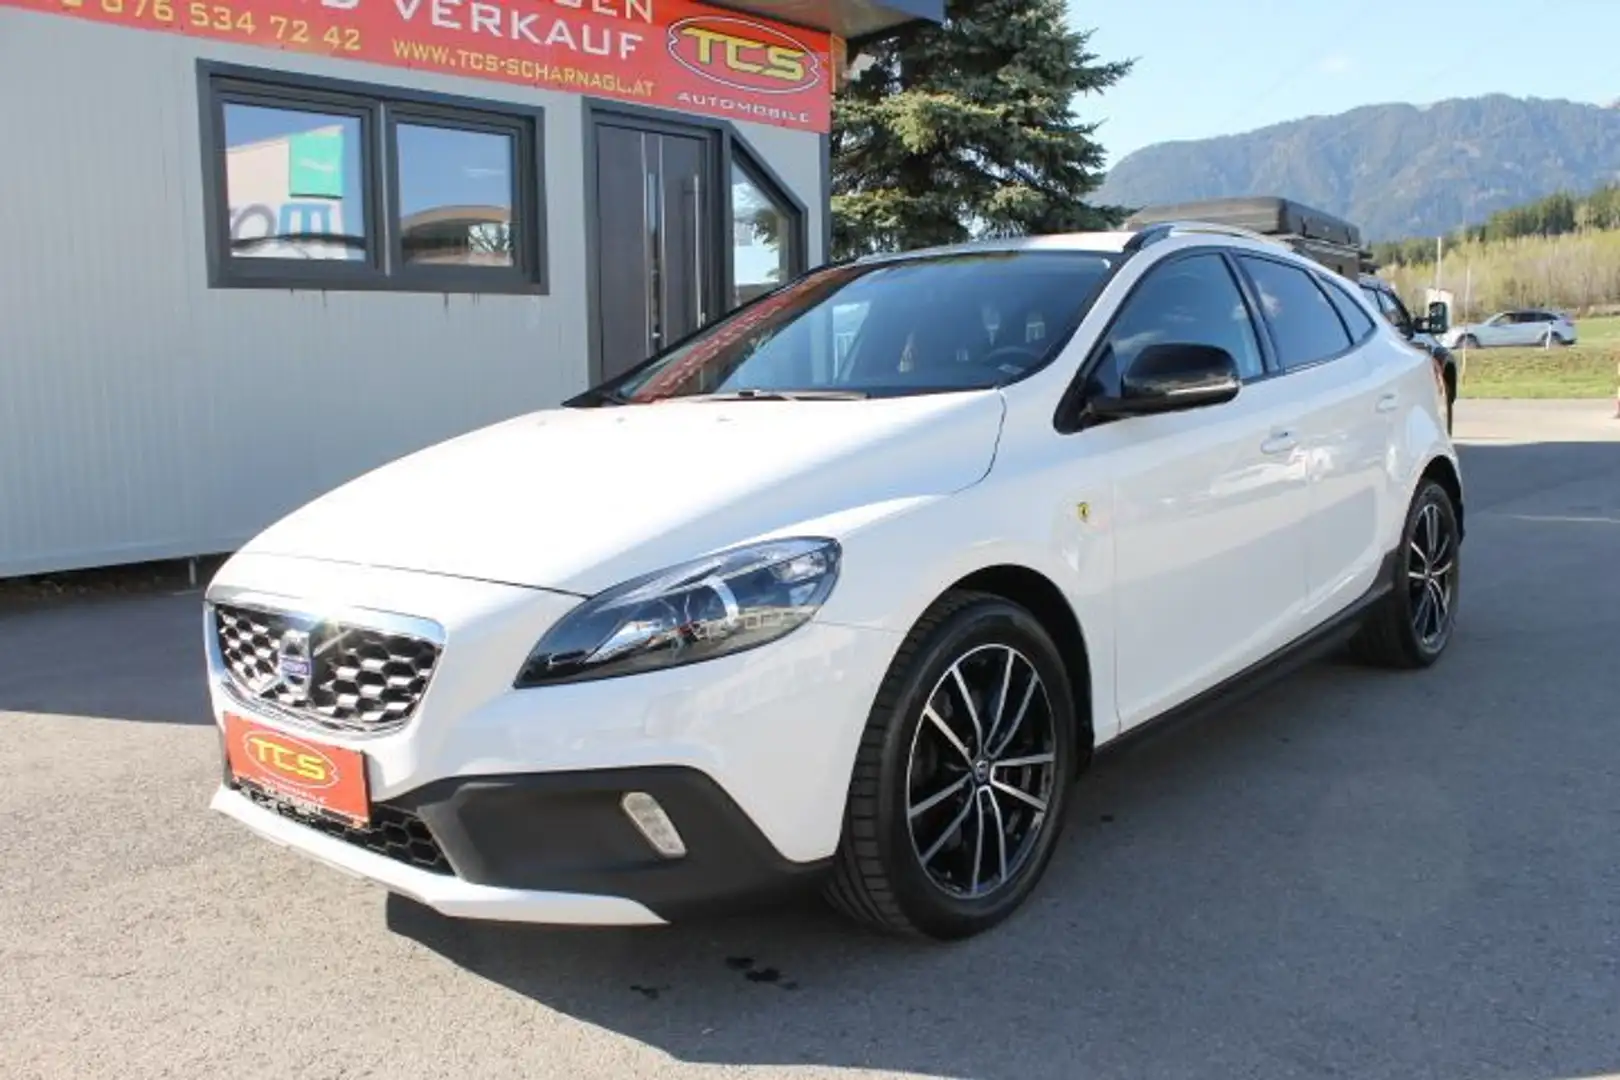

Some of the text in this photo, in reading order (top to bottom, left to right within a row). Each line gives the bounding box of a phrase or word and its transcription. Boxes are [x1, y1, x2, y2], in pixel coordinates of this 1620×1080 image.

[189, 3, 256, 35] 534
[270, 16, 309, 43] 72
[323, 26, 361, 51] 42
[395, 0, 643, 60] VERKAUF
[681, 27, 806, 81] TCS
[676, 91, 809, 123] AUTOMOBILE
[249, 737, 325, 780] TCS
